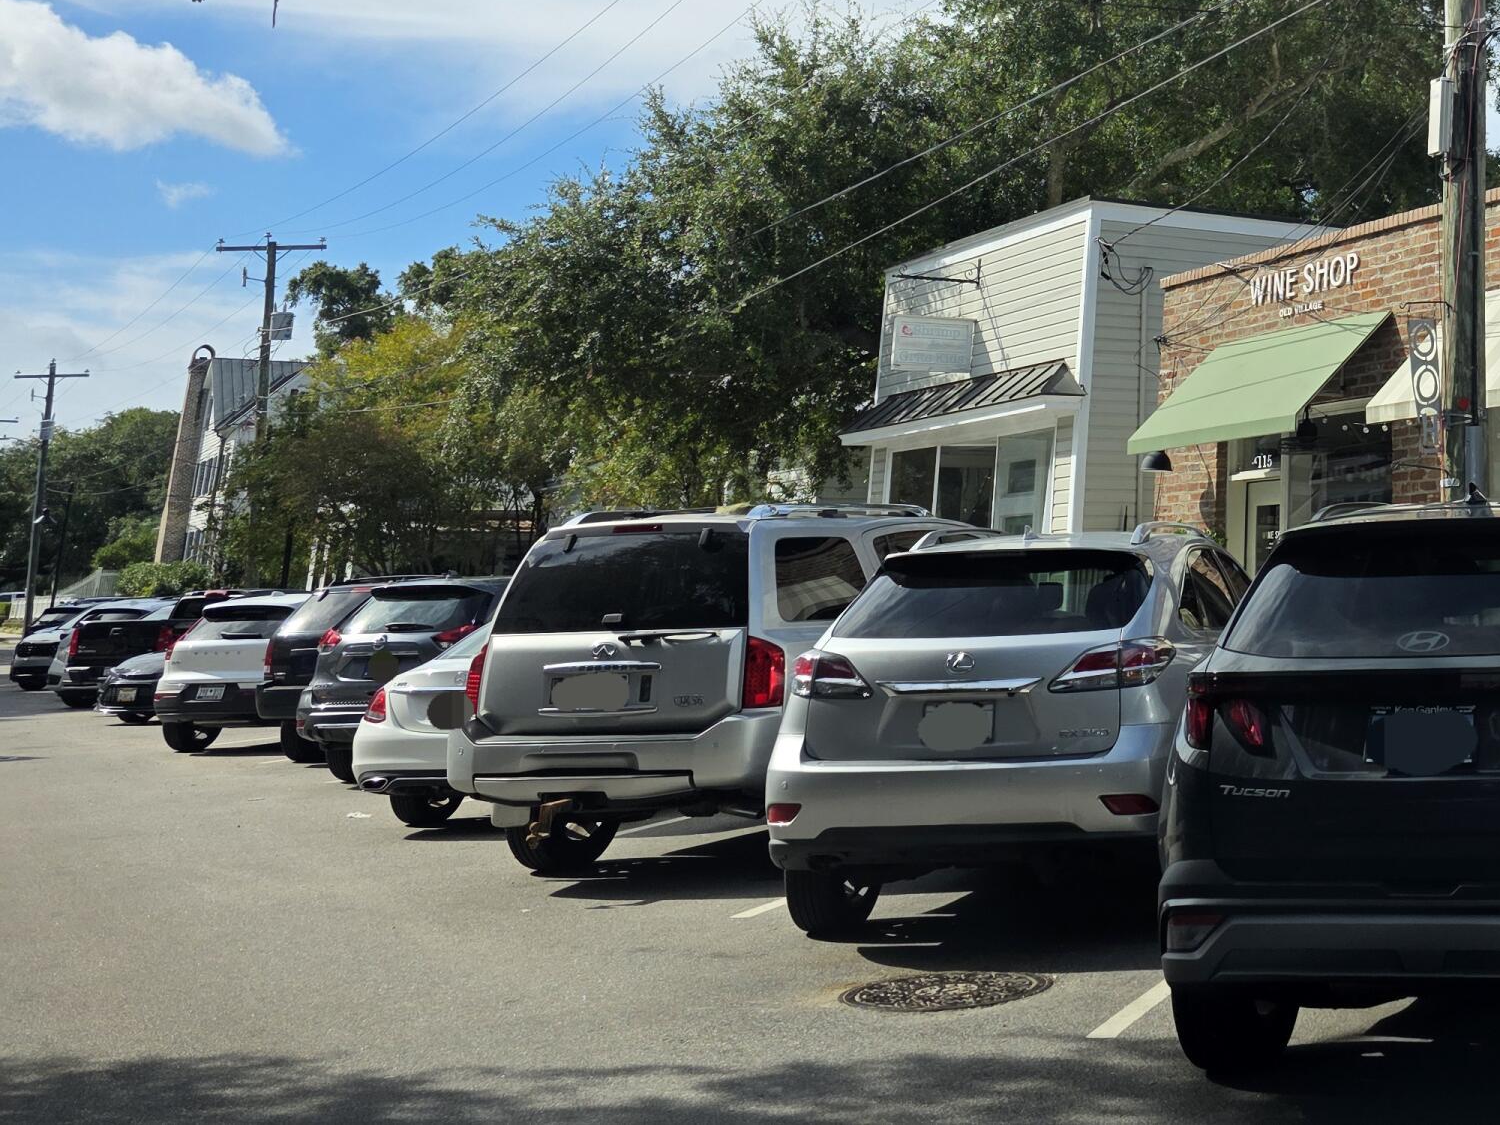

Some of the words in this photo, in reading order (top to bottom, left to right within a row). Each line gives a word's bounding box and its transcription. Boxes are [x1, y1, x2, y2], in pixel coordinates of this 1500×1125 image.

[1249, 268, 1298, 306] WINE
[1302, 252, 1359, 293] SHOP
[1279, 307, 1292, 317] OLD
[1294, 300, 1324, 315] VILLAGE
[1251, 454, 1273, 468] 115
[1220, 784, 1291, 798] Tucson
